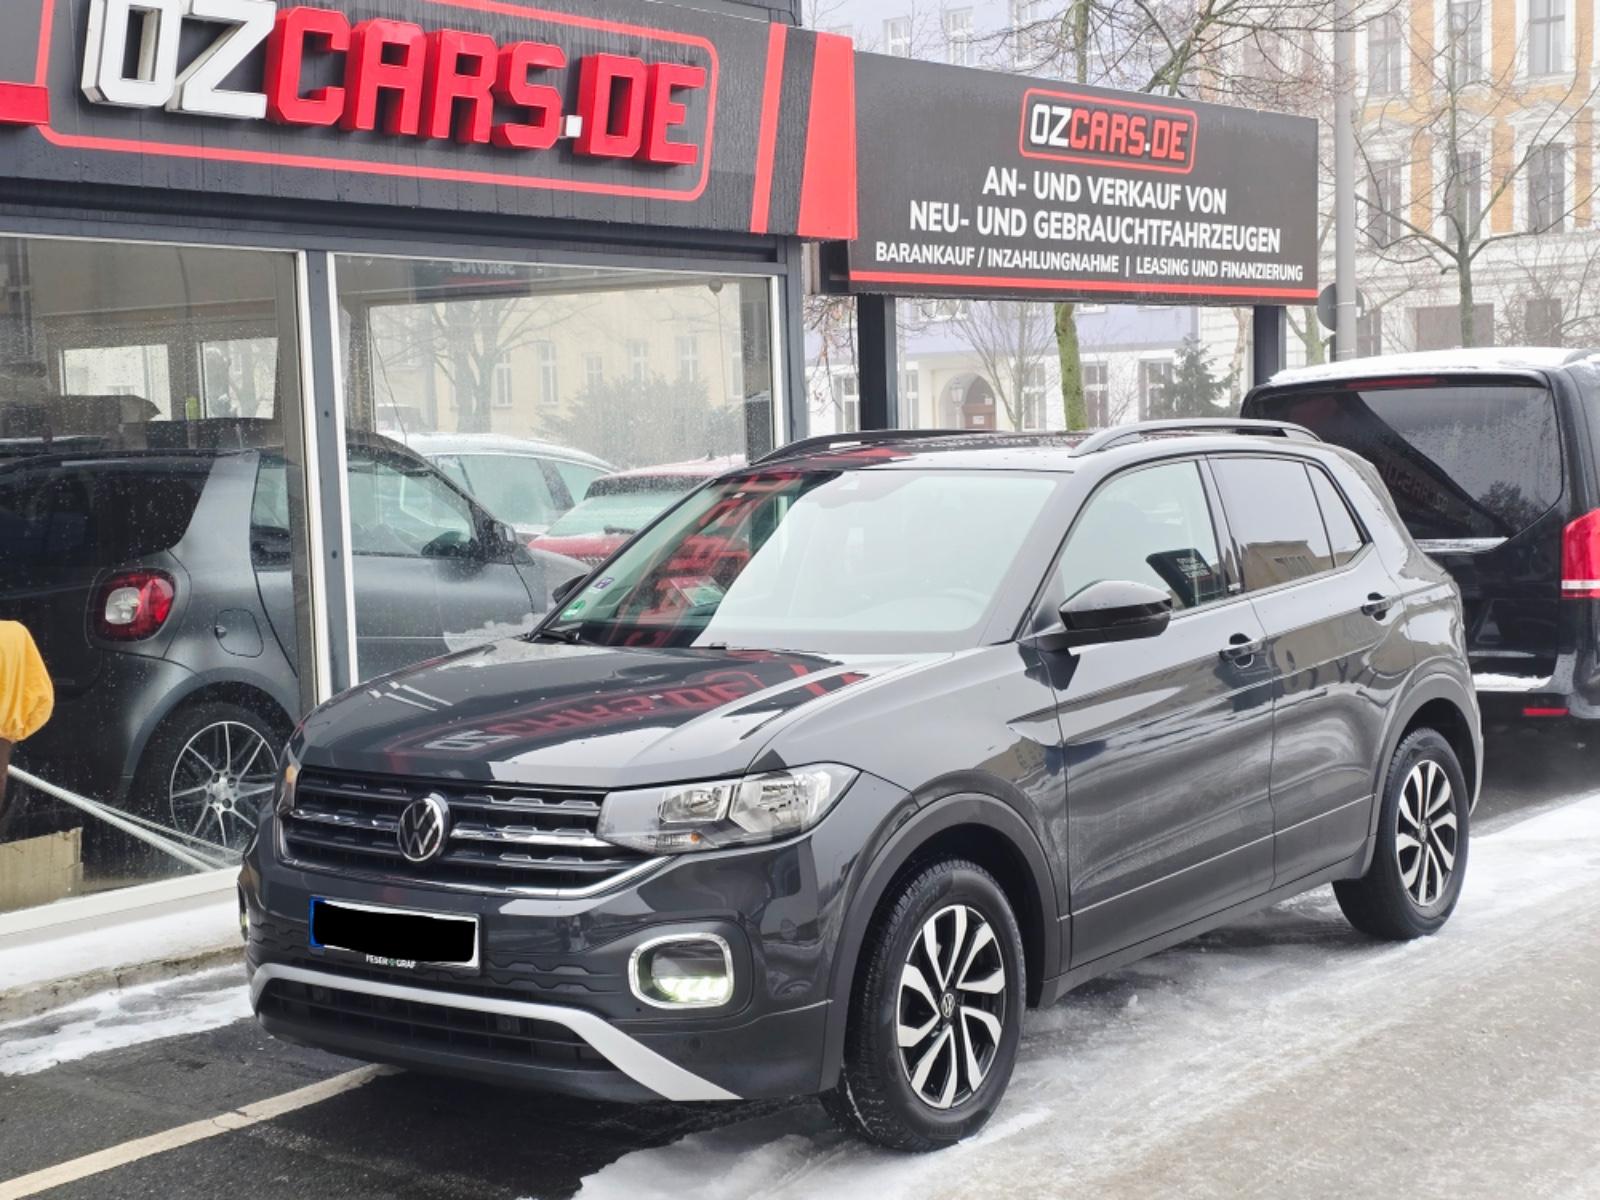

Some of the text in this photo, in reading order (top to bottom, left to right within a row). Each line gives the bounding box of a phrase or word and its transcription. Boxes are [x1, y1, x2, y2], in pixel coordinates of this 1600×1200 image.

[81, 0, 706, 166] OZCARS.DE
[1030, 103, 1188, 161] OZCARS.DE
[982, 166, 1227, 215] AN- UND VERKAUF VON
[909, 200, 1281, 253] NEU- UND GEBRAUCHTFAHRZEUGEN
[875, 241, 975, 266] BARANKAUF
[987, 249, 1119, 273] INZAHLUNGNAHME
[1136, 256, 1189, 276] LEASING
[1192, 260, 1218, 278] UND
[1220, 261, 1304, 281] FINANZIERUNG
